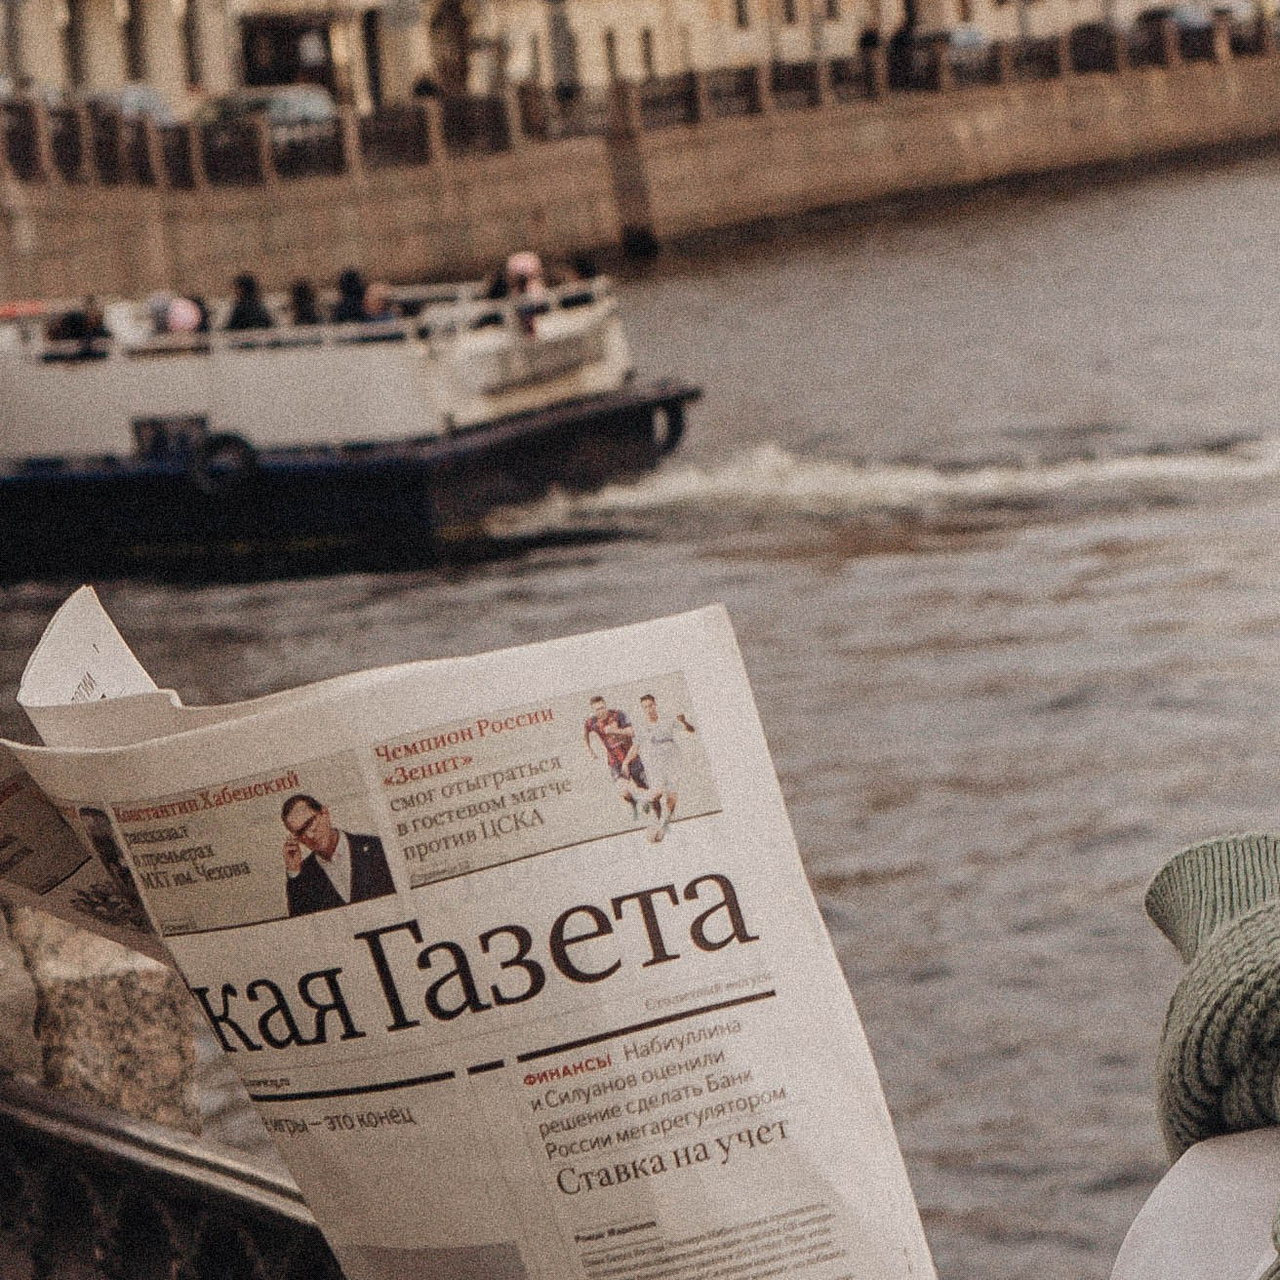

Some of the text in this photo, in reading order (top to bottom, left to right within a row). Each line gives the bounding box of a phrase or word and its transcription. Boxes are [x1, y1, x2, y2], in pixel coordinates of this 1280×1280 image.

[375, 708, 554, 763] Чемпион России
[199, 770, 300, 810] Хабенский
[383, 756, 473, 787] «Зенит»
[390, 756, 562, 812] смог отыграться
[397, 778, 572, 837] в гостевом матче
[403, 808, 545, 862] против ЦСКА
[354, 872, 760, 1034] Газета
[523, 1021, 742, 1087] ФИНАНСЫ Набиуллина
[530, 1050, 726, 1112] и Силуанов оценили
[324, 1115, 355, 1131] это
[357, 1107, 417, 1130] конец
[538, 1106, 622, 1139] решение
[626, 1086, 702, 1115] сделать
[545, 1086, 787, 1160] России мегарегулятором
[557, 1120, 790, 1195] Ставка на учет
